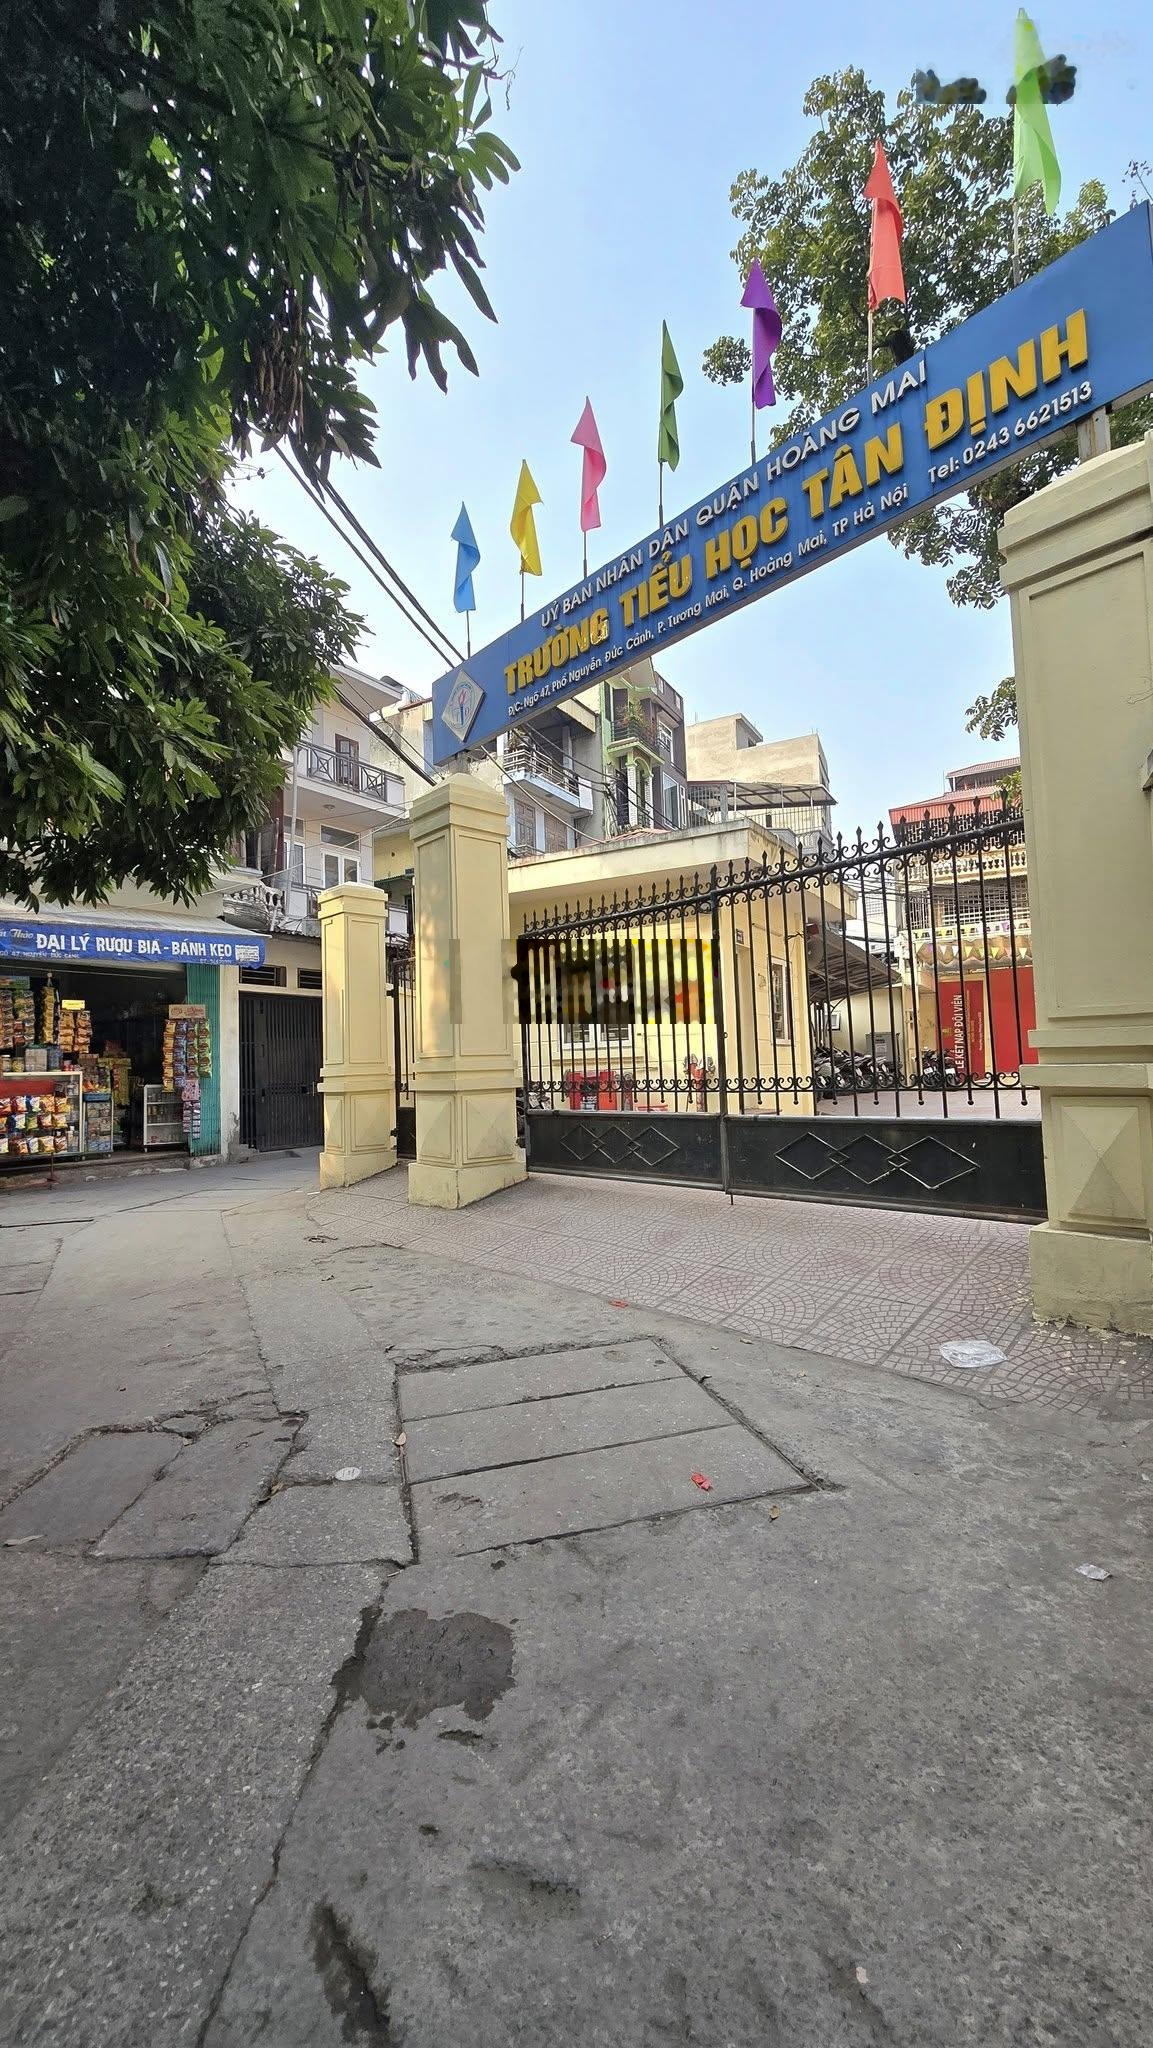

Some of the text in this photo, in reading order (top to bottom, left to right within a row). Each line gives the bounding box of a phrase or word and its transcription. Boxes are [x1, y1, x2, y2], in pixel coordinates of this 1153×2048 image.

[504, 308, 1088, 694] TRƯỜNG TIỂU HỌC TÂN ĐỊNH
[562, 583, 592, 614] BAN
[596, 548, 643, 592] NHÂN
[648, 518, 688, 558] DÂN
[696, 472, 759, 525] QUẬN
[766, 407, 861, 481] HOÀNG
[871, 360, 926, 414] MAI
[928, 380, 1093, 484] Tel: 0243 6621513
[552, 670, 567, 692] Phố
[569, 656, 602, 683] Nguyễn
[605, 645, 623, 662] Đức
[626, 628, 654, 650] Cảnh,
[705, 584, 730, 607] Mai,
[732, 576, 747, 591] Q.
[750, 551, 792, 582] Hoàng
[798, 530, 827, 557] Mai,
[832, 517, 849, 539] TP
[853, 499, 875, 527] Hà
[880, 482, 908, 509] Nội
[36, 933, 66, 953] ĐẠI
[71, 933, 90, 951] LÝ
[95, 937, 132, 956] RƯỢU
[171, 938, 207, 956] BÁNH
[209, 943, 232, 959] KẸO
[951, 995, 962, 1013] VIÊN
